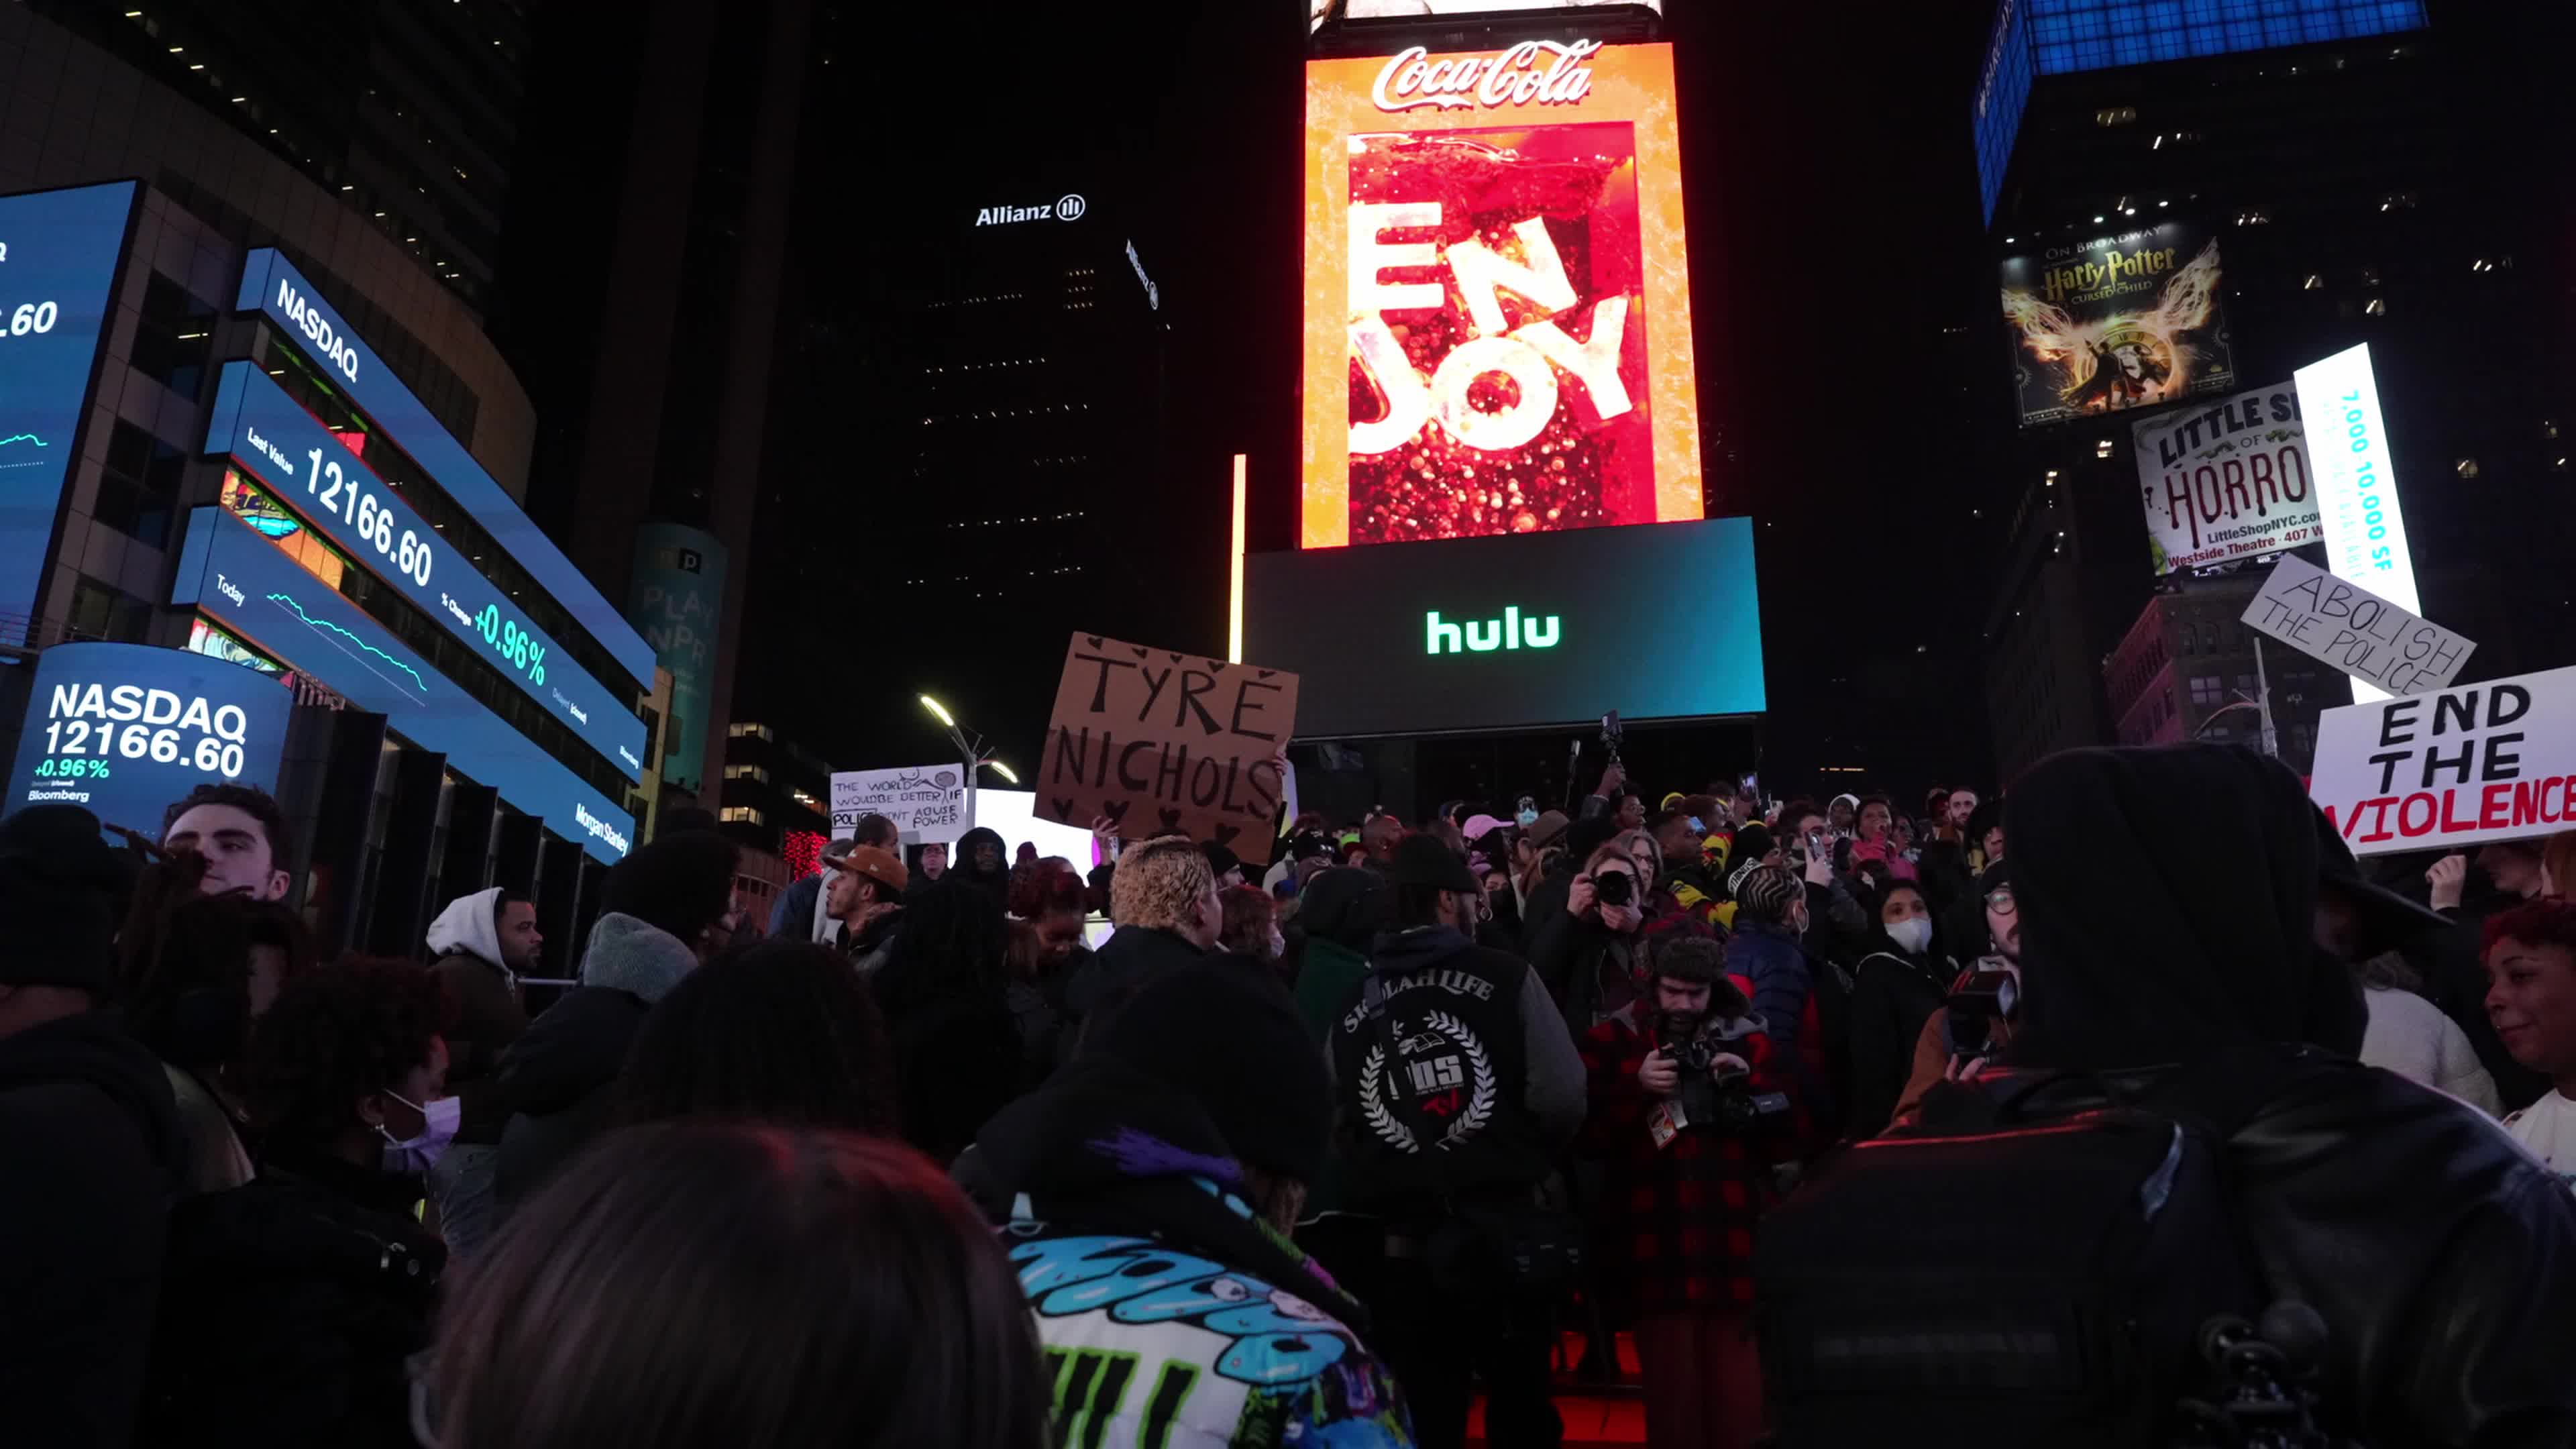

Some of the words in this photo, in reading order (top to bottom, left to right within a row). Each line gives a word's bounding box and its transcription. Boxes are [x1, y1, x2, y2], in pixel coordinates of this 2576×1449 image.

[1372, 39, 1603, 113] Coca-Cola
[975, 205, 1052, 227] Allianz
[2047, 246, 2071, 260] ON
[2076, 225, 2161, 254] BROADWAY
[2044, 262, 2106, 301] Harry
[2104, 247, 2177, 286] Potter
[2071, 286, 2114, 306] CURSED
[2114, 280, 2153, 295] CHILD
[277, 278, 359, 384] NASDAQ
[248, 427, 269, 454] Last
[269, 444, 294, 475] Value
[2159, 396, 2264, 468] LITTLE
[2240, 433, 2263, 449] OF
[307, 447, 432, 587] 12166.60
[2168, 545, 2225, 568] Westside
[2226, 535, 2276, 555] Theatre
[2284, 528, 2308, 543] 407
[2371, 545, 2394, 571] SF
[217, 574, 246, 607] Today
[475, 604, 545, 686] +0.96%
[1427, 606, 1560, 654] hulu
[2261, 595, 2322, 646] THE
[2323, 630, 2438, 696] POLICE
[2282, 575, 2463, 676] ABOLISH
[49, 683, 247, 745] NASDAQ
[1075, 653, 1283, 741] TYRE
[2379, 684, 2531, 747] END
[34, 758, 110, 779] +0.96%
[46, 720, 244, 778] 12166.60
[1053, 724, 1284, 819] NICHOLS
[2368, 732, 2525, 795] THE
[28, 789, 90, 803] Bloomberg
[835, 782, 859, 792] THE
[867, 780, 913, 792] WORLD
[914, 804, 957, 818] ABUSE
[949, 789, 963, 800] IF
[2323, 774, 2576, 843] VIOLENCE
[575, 802, 604, 838] Morgan
[603, 822, 629, 858] Stanley
[912, 814, 959, 829] POWER
[1438, 969, 1495, 1001] LIFE
